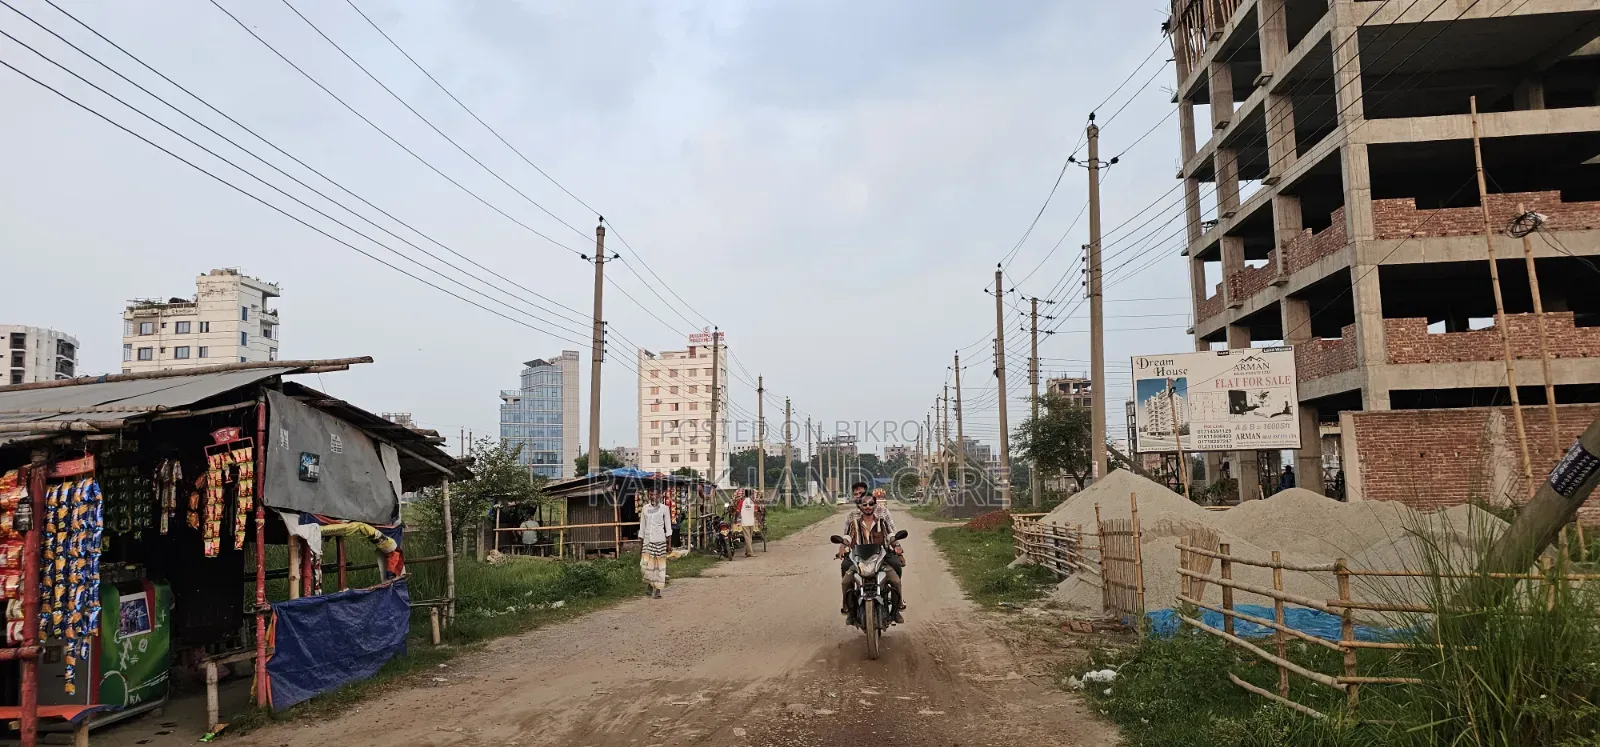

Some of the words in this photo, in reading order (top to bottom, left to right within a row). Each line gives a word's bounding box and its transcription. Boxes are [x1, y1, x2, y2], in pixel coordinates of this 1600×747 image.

[1136, 358, 1174, 369] Dream
[1234, 362, 1270, 372] ARMAN
[1153, 367, 1188, 376] House
[1215, 378, 1240, 388] FLAT
[1243, 377, 1264, 387] FOR
[1265, 375, 1292, 386] SALE
